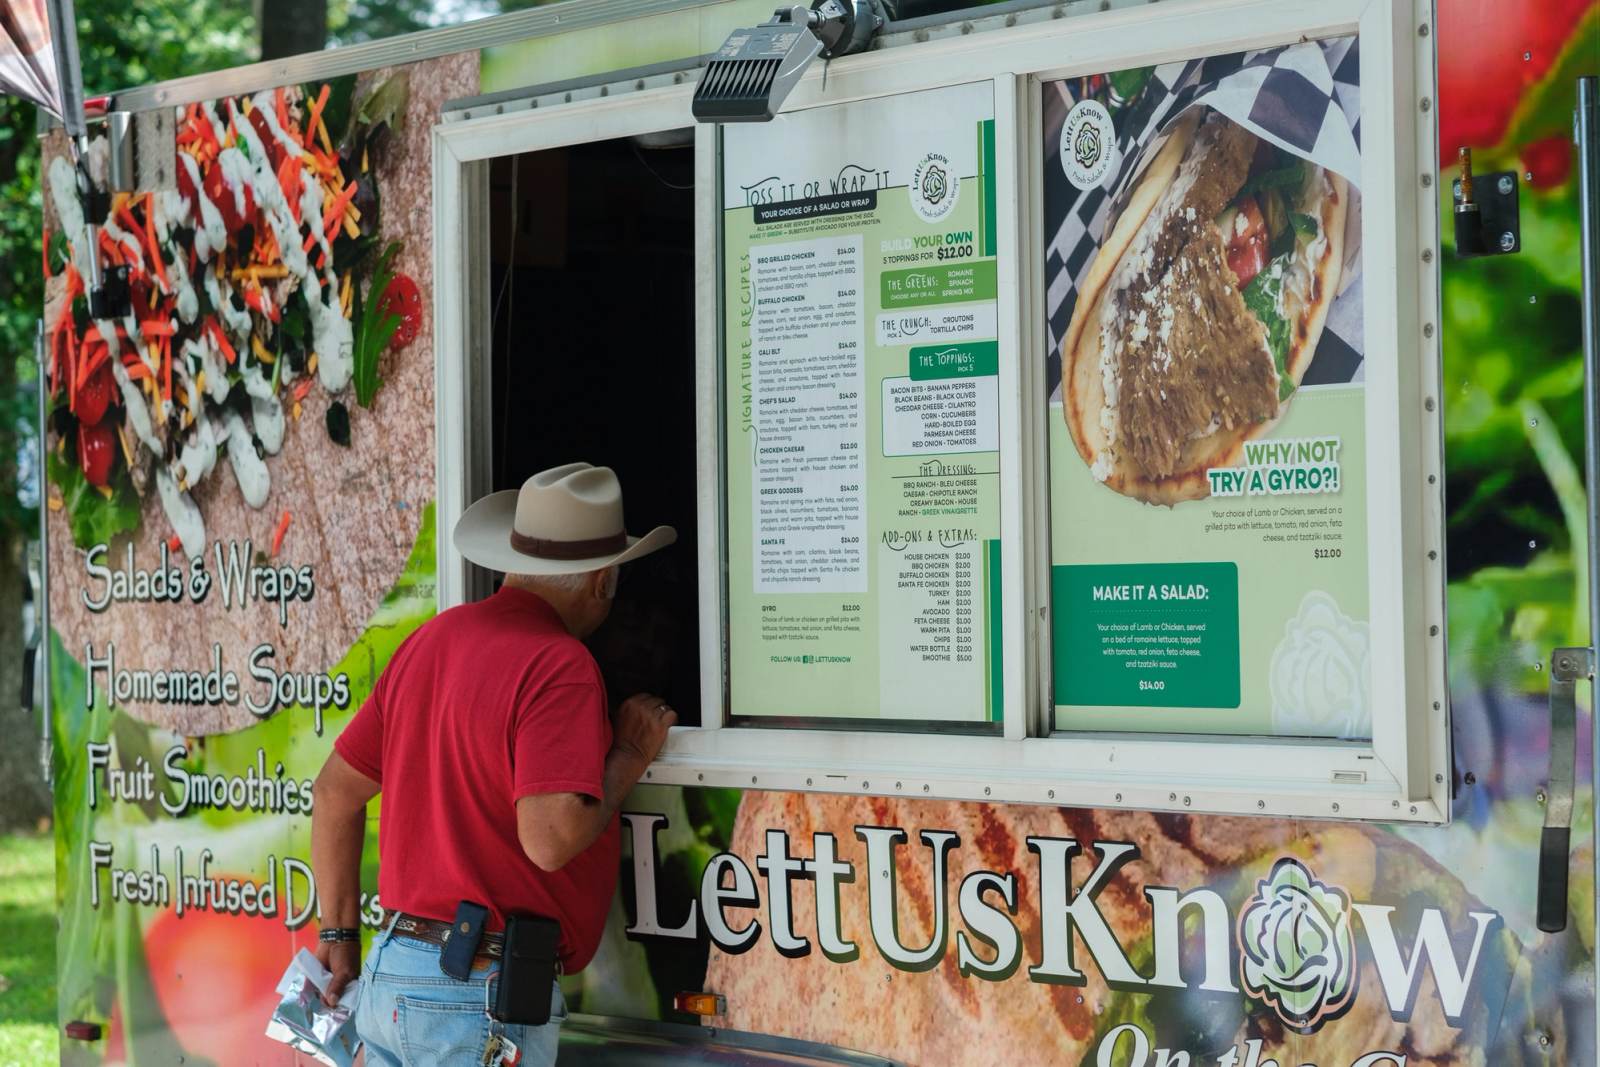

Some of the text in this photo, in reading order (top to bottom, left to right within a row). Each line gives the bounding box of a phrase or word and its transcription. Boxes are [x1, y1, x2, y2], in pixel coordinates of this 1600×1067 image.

[741, 164, 889, 206] TOSS IT OR WRAP IT
[761, 211, 778, 219] YOUR
[779, 208, 801, 217] CHOICE
[802, 205, 811, 214] OF
[819, 202, 839, 212] SALAD
[850, 198, 870, 208] WRAP
[914, 235, 942, 248] YOUR
[946, 232, 972, 244] OWN
[888, 254, 919, 263] TOPPINGS
[938, 246, 972, 260] $12.00
[741, 254, 756, 327] RECIPES
[888, 280, 901, 290] THE
[882, 320, 896, 330] THE
[920, 356, 933, 366] THE
[1246, 441, 1337, 465] WHY NOT
[920, 466, 933, 477] THE
[1209, 467, 1337, 492] TRY A GYRO?!
[882, 531, 921, 551] ADD-ONS
[928, 530, 932, 541] &
[1315, 549, 1341, 558] $12.00
[81, 540, 313, 627] Salads & Wraps
[1093, 585, 1209, 600] MAKE IT A SALAD:
[85, 642, 349, 736] Homemade Soups
[1139, 681, 1164, 690] $14.00
[87, 743, 313, 815] Fruit Smoothies
[89, 841, 168, 906] Fresh
[175, 847, 277, 914] Infused
[1216, 1039, 1318, 1067] th
